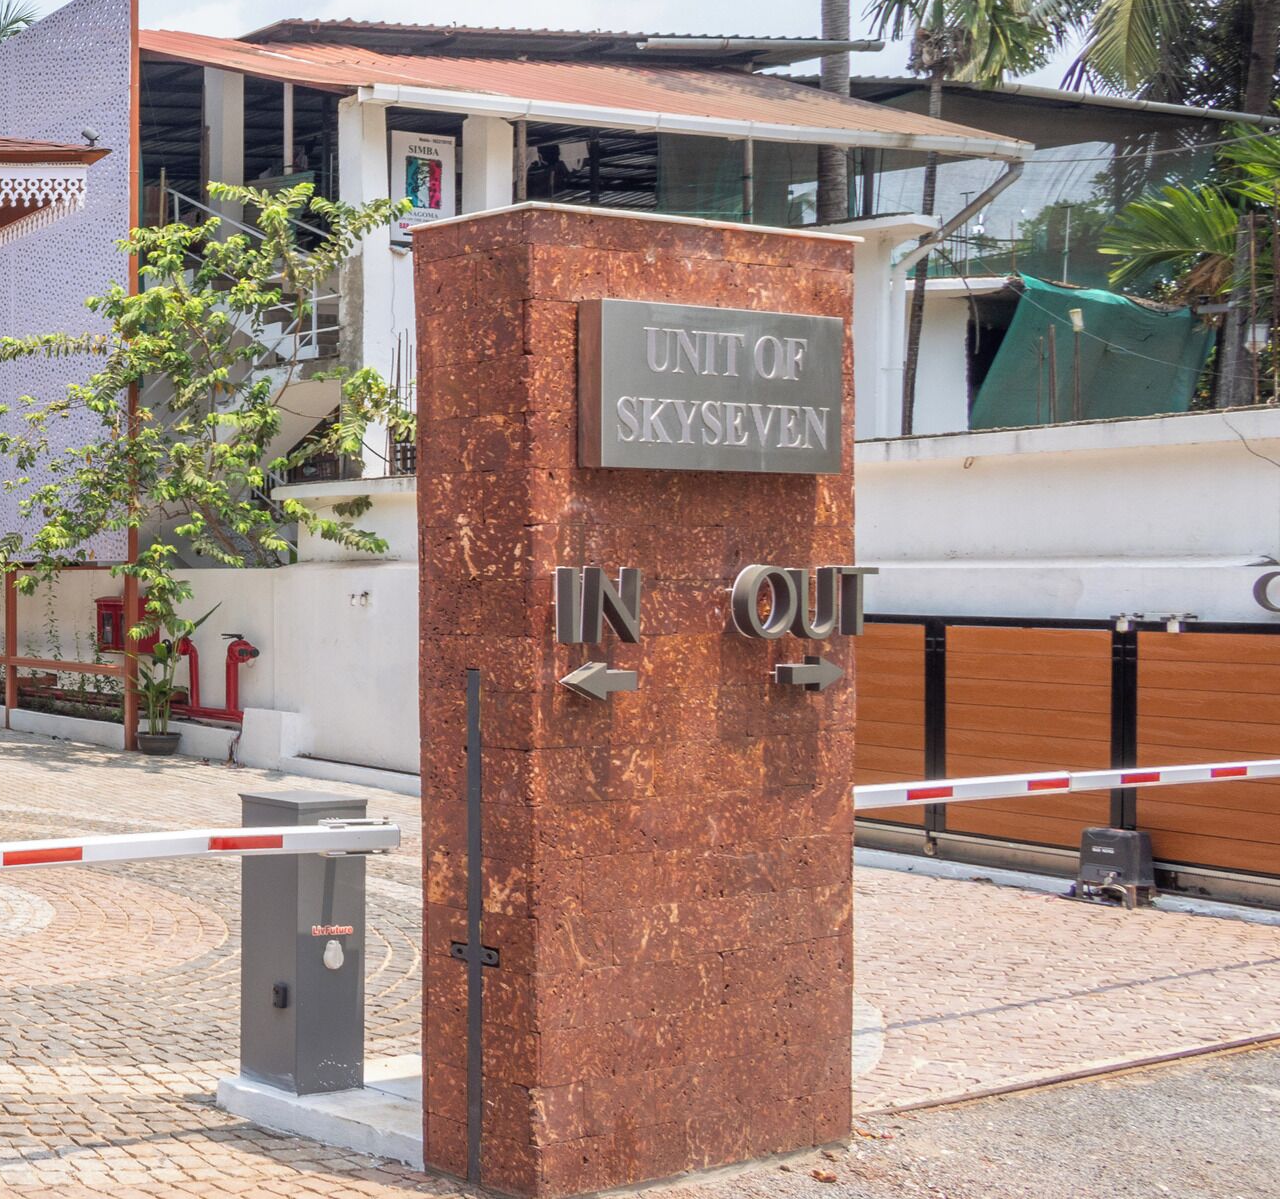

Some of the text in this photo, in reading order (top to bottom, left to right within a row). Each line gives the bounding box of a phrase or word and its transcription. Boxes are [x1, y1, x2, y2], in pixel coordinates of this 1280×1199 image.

[408, 145, 439, 157] SIMBA
[643, 326, 808, 382] UNIT OF
[616, 396, 830, 450] SKYSEVEN
[555, 564, 879, 643] IN OUT
